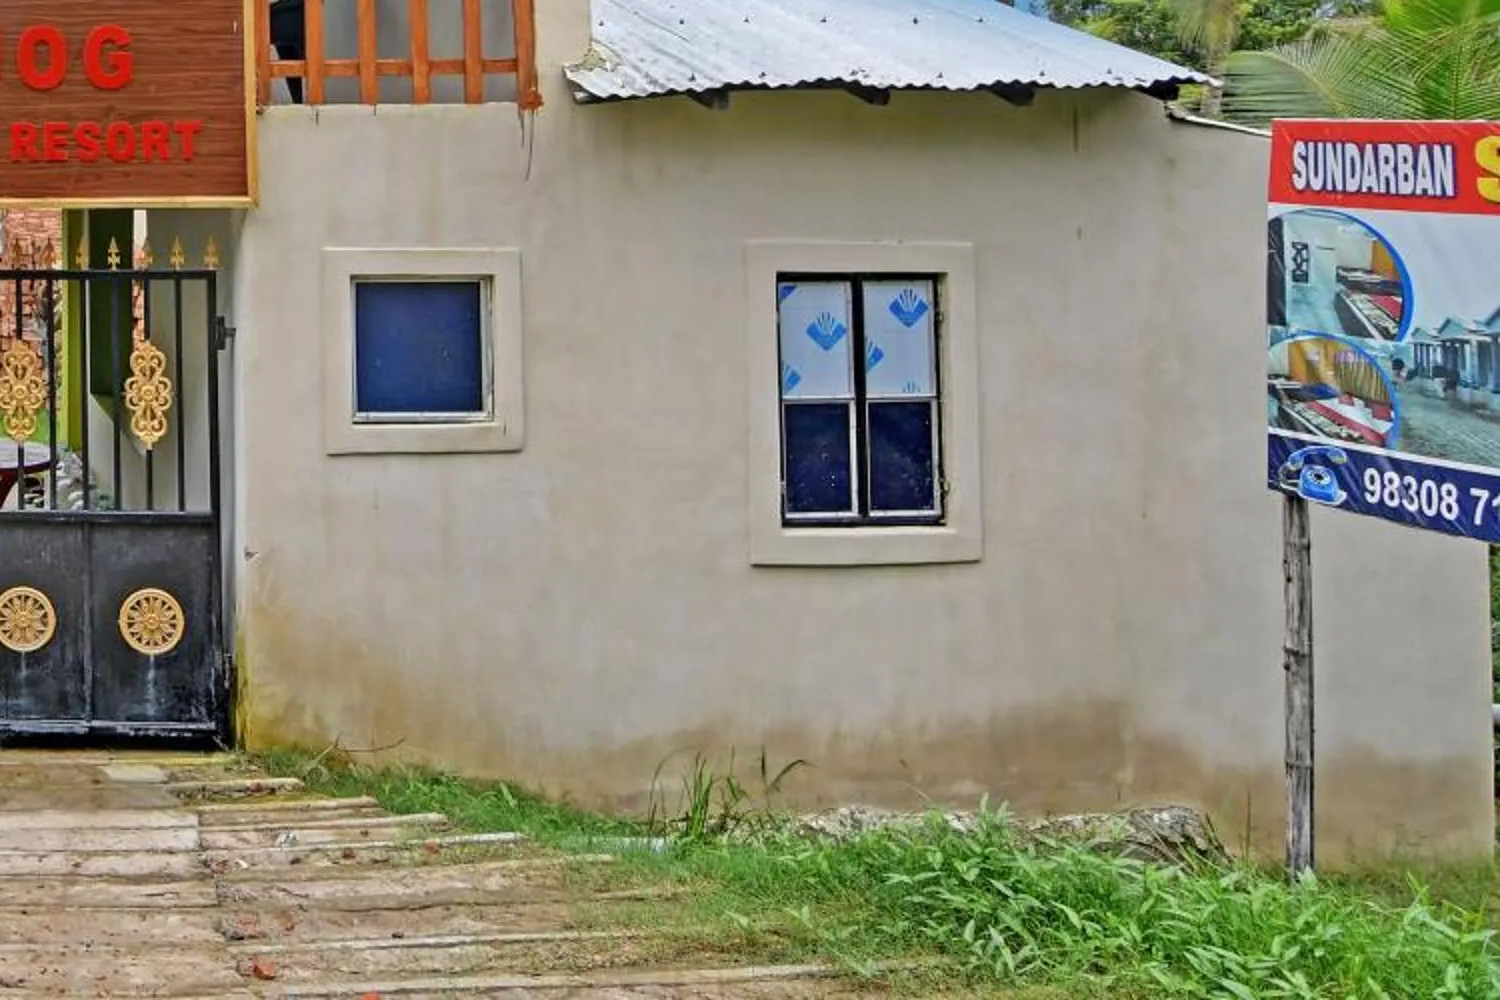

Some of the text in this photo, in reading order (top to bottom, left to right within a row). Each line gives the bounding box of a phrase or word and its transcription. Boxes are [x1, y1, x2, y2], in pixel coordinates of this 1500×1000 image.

[9, 120, 202, 163] RESORT
[1291, 139, 1456, 197] SUNDARBAN
[1363, 467, 1459, 521] 98308
